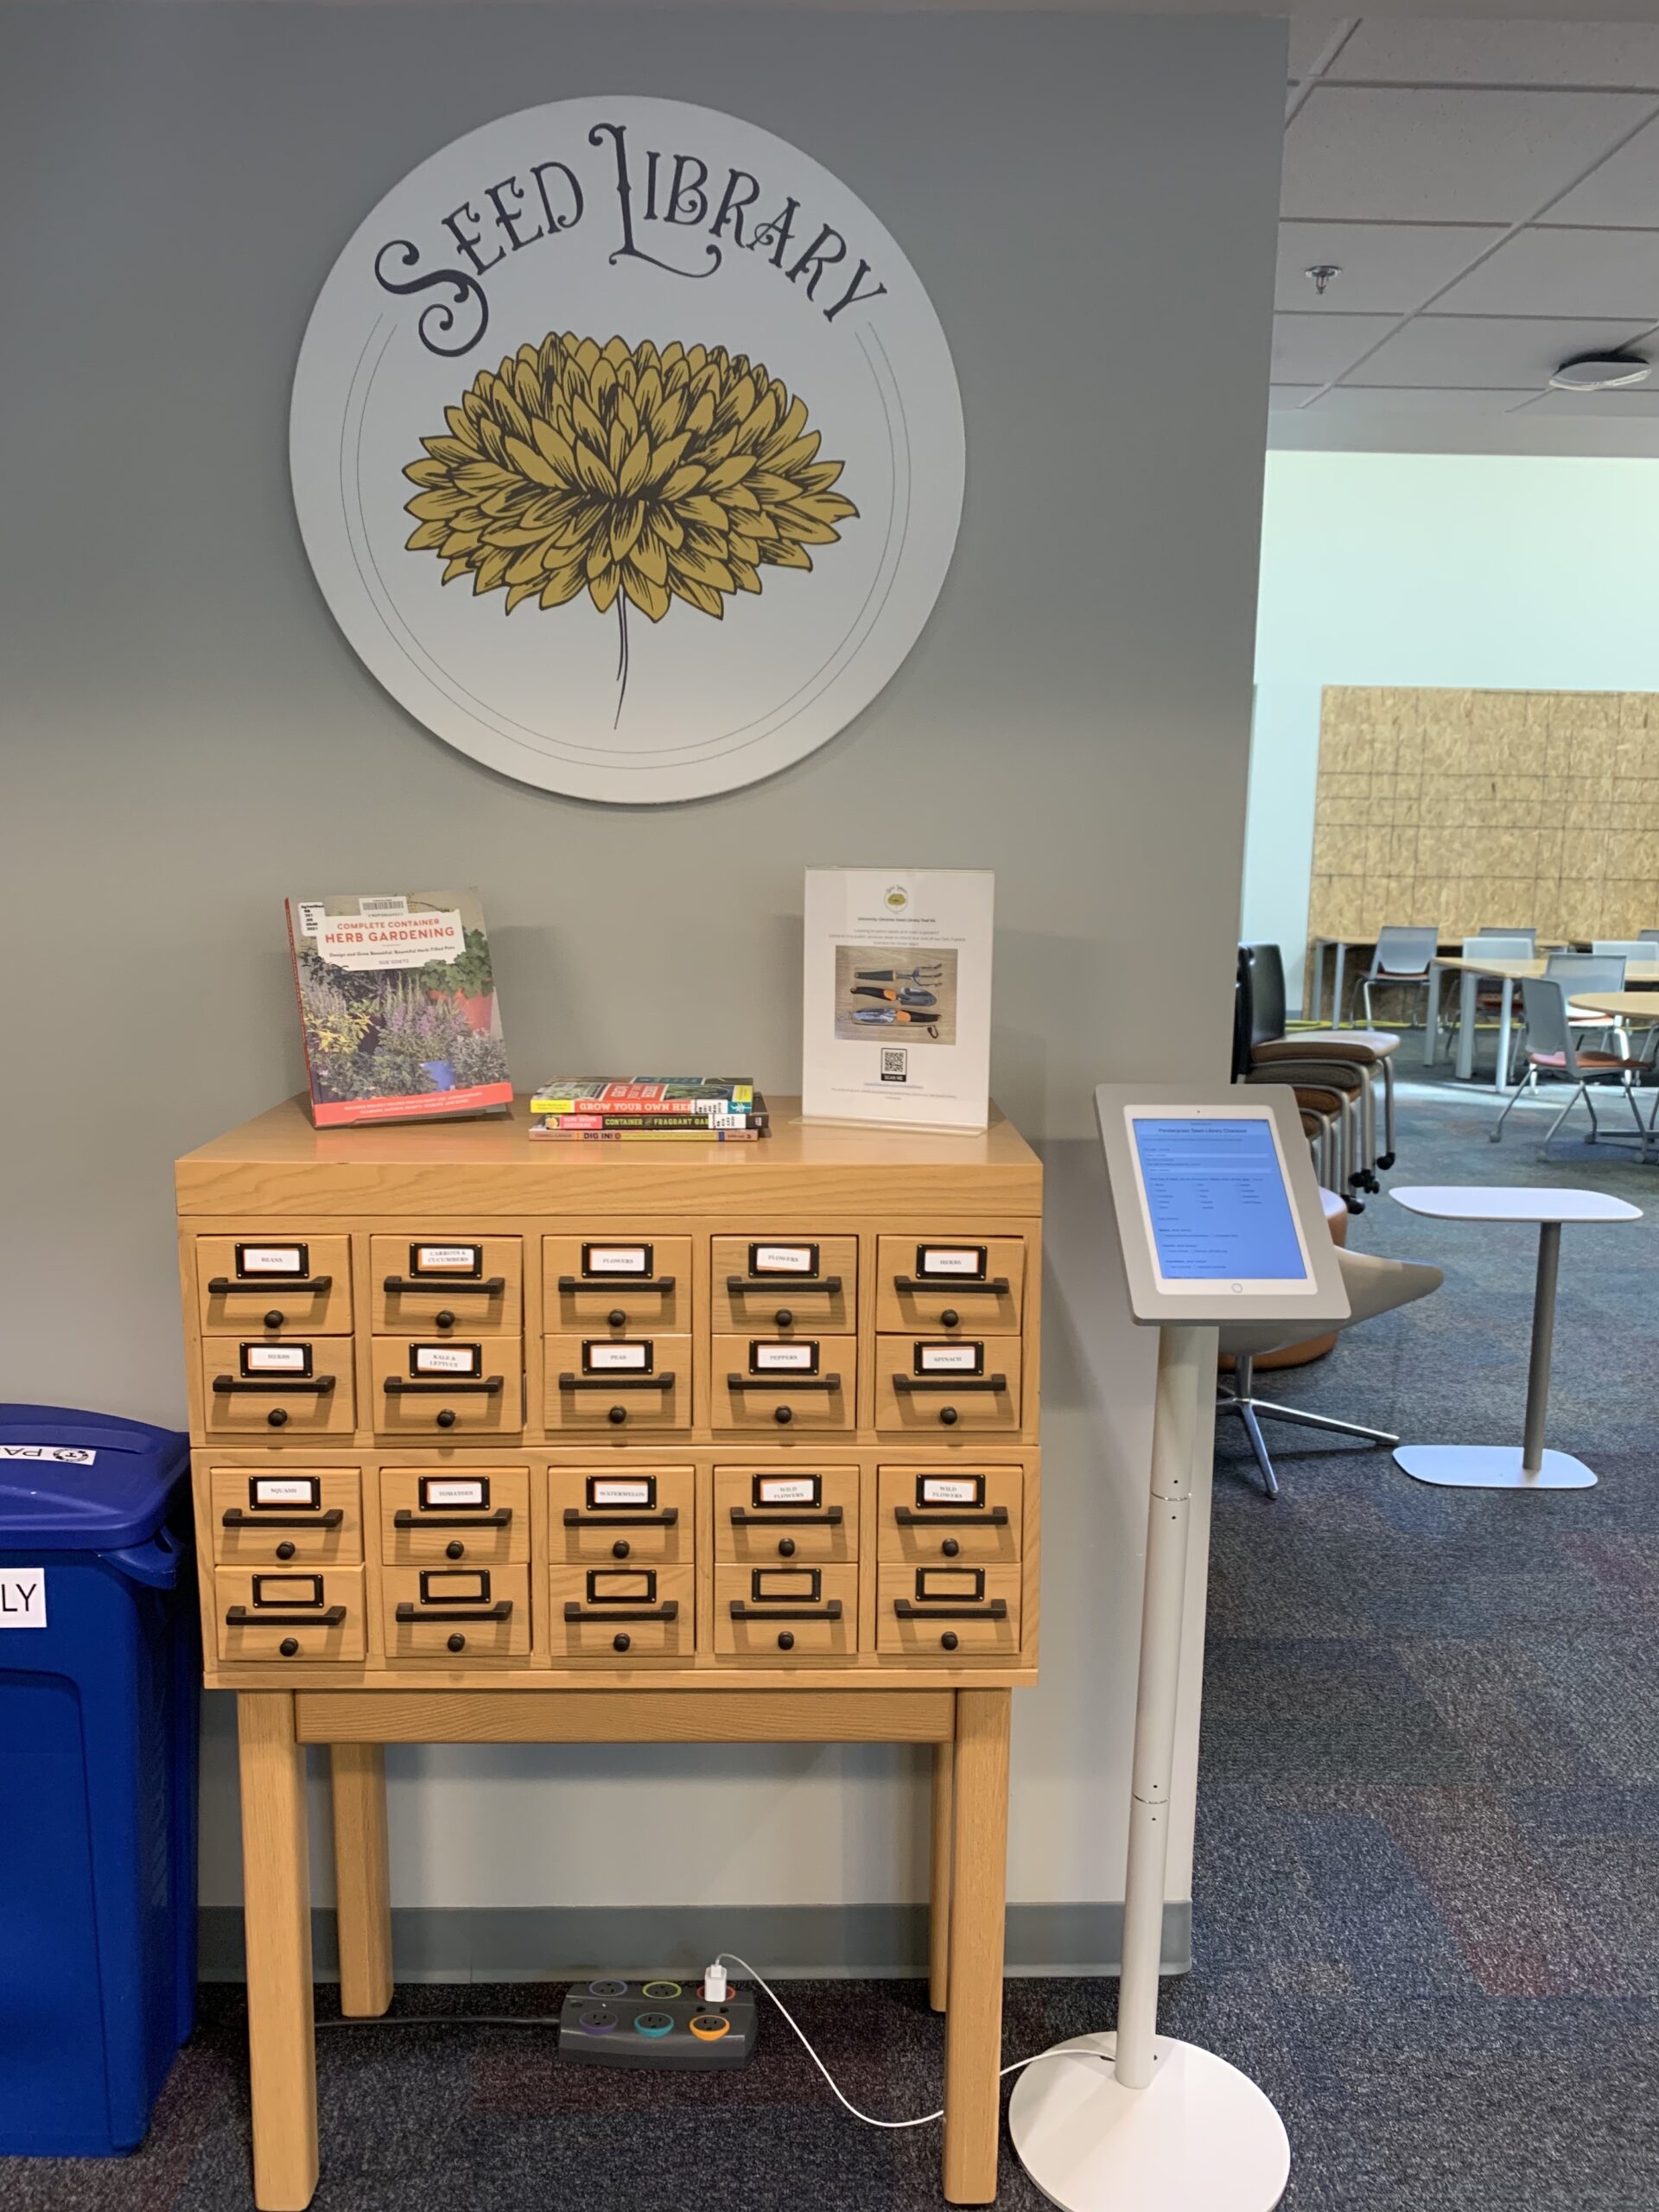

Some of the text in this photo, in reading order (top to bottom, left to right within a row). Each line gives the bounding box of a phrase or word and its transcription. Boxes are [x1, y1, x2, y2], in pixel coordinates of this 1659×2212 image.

[374, 123, 887, 356] SEED LIBRARY
[337, 918, 440, 930] COMPLETE CONTAINER
[325, 926, 454, 944] HERB GARDENING
[579, 1103, 613, 1111] GROW
[613, 1103, 645, 1111] YOUR
[646, 1103, 671, 1111] OWN
[768, 1254, 799, 1262] FLOWERS
[0, 1447, 42, 1457] PA
